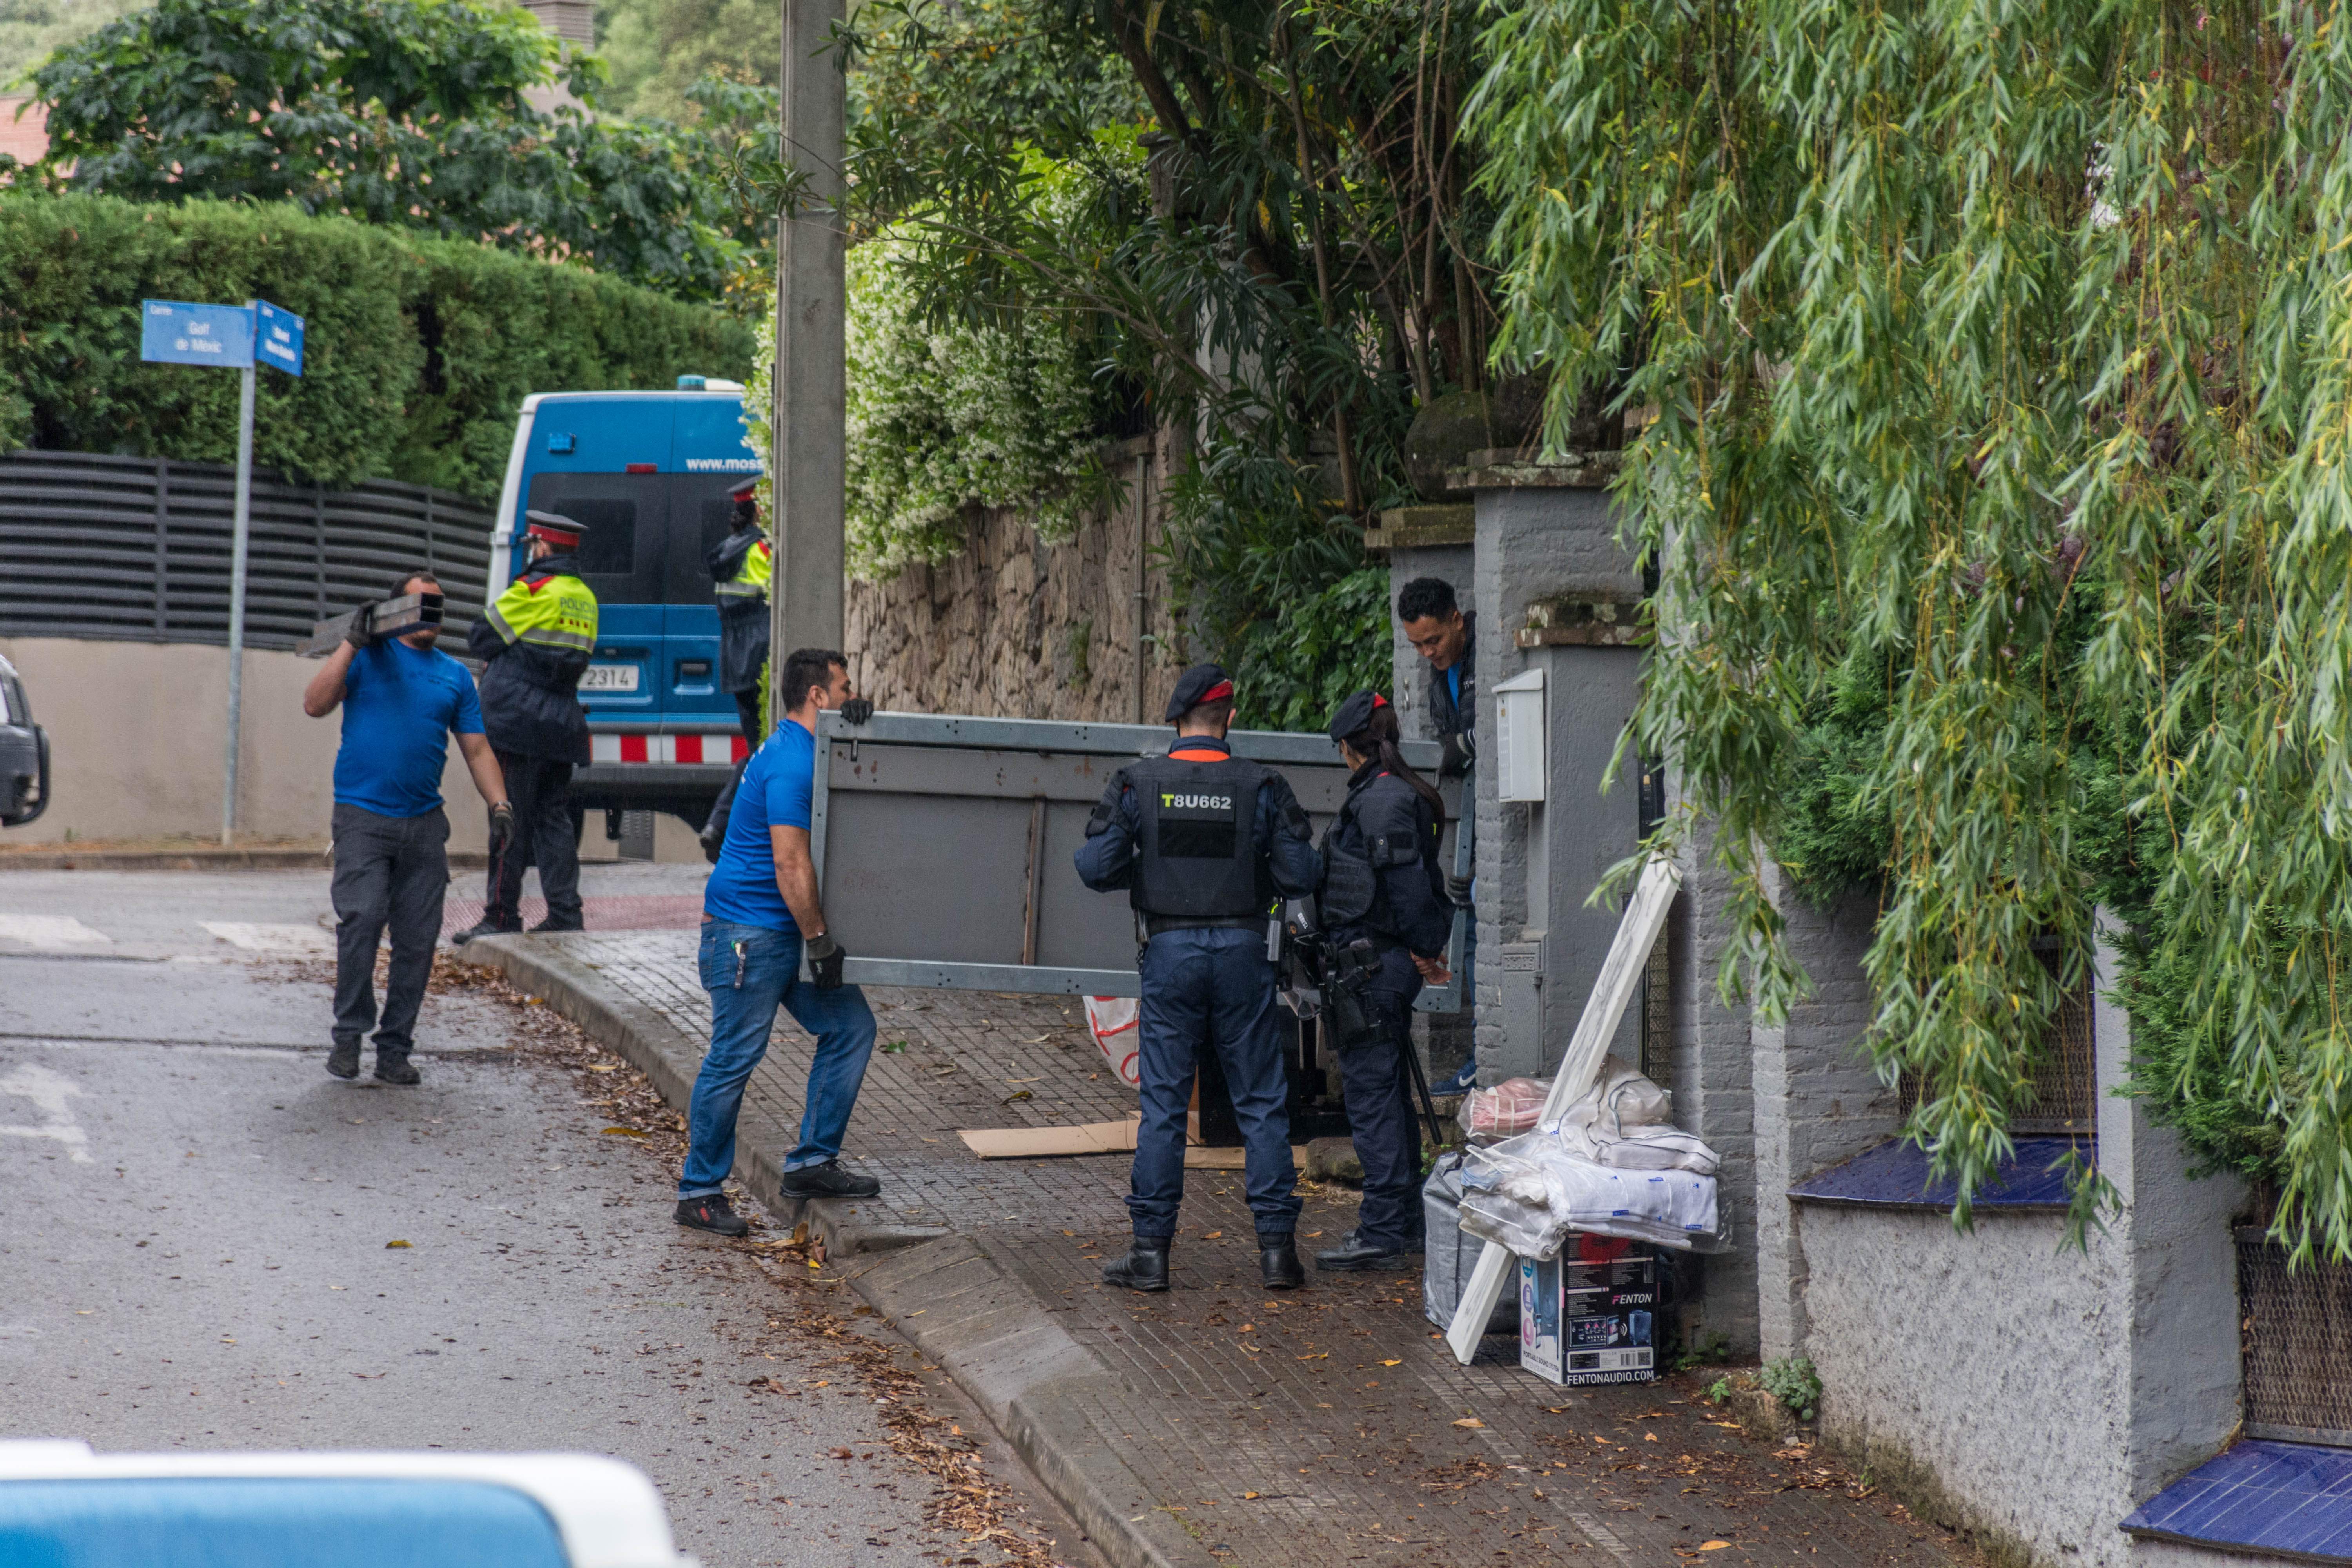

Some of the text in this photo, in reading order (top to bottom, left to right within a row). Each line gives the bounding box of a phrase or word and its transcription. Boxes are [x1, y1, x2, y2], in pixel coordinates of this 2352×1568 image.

[587, 668, 628, 686] 2314
[1161, 793, 1231, 809] T8U662
[1612, 1294, 1652, 1305] FENTON
[1568, 1371, 1654, 1385] FENTONAUDIO.COM
